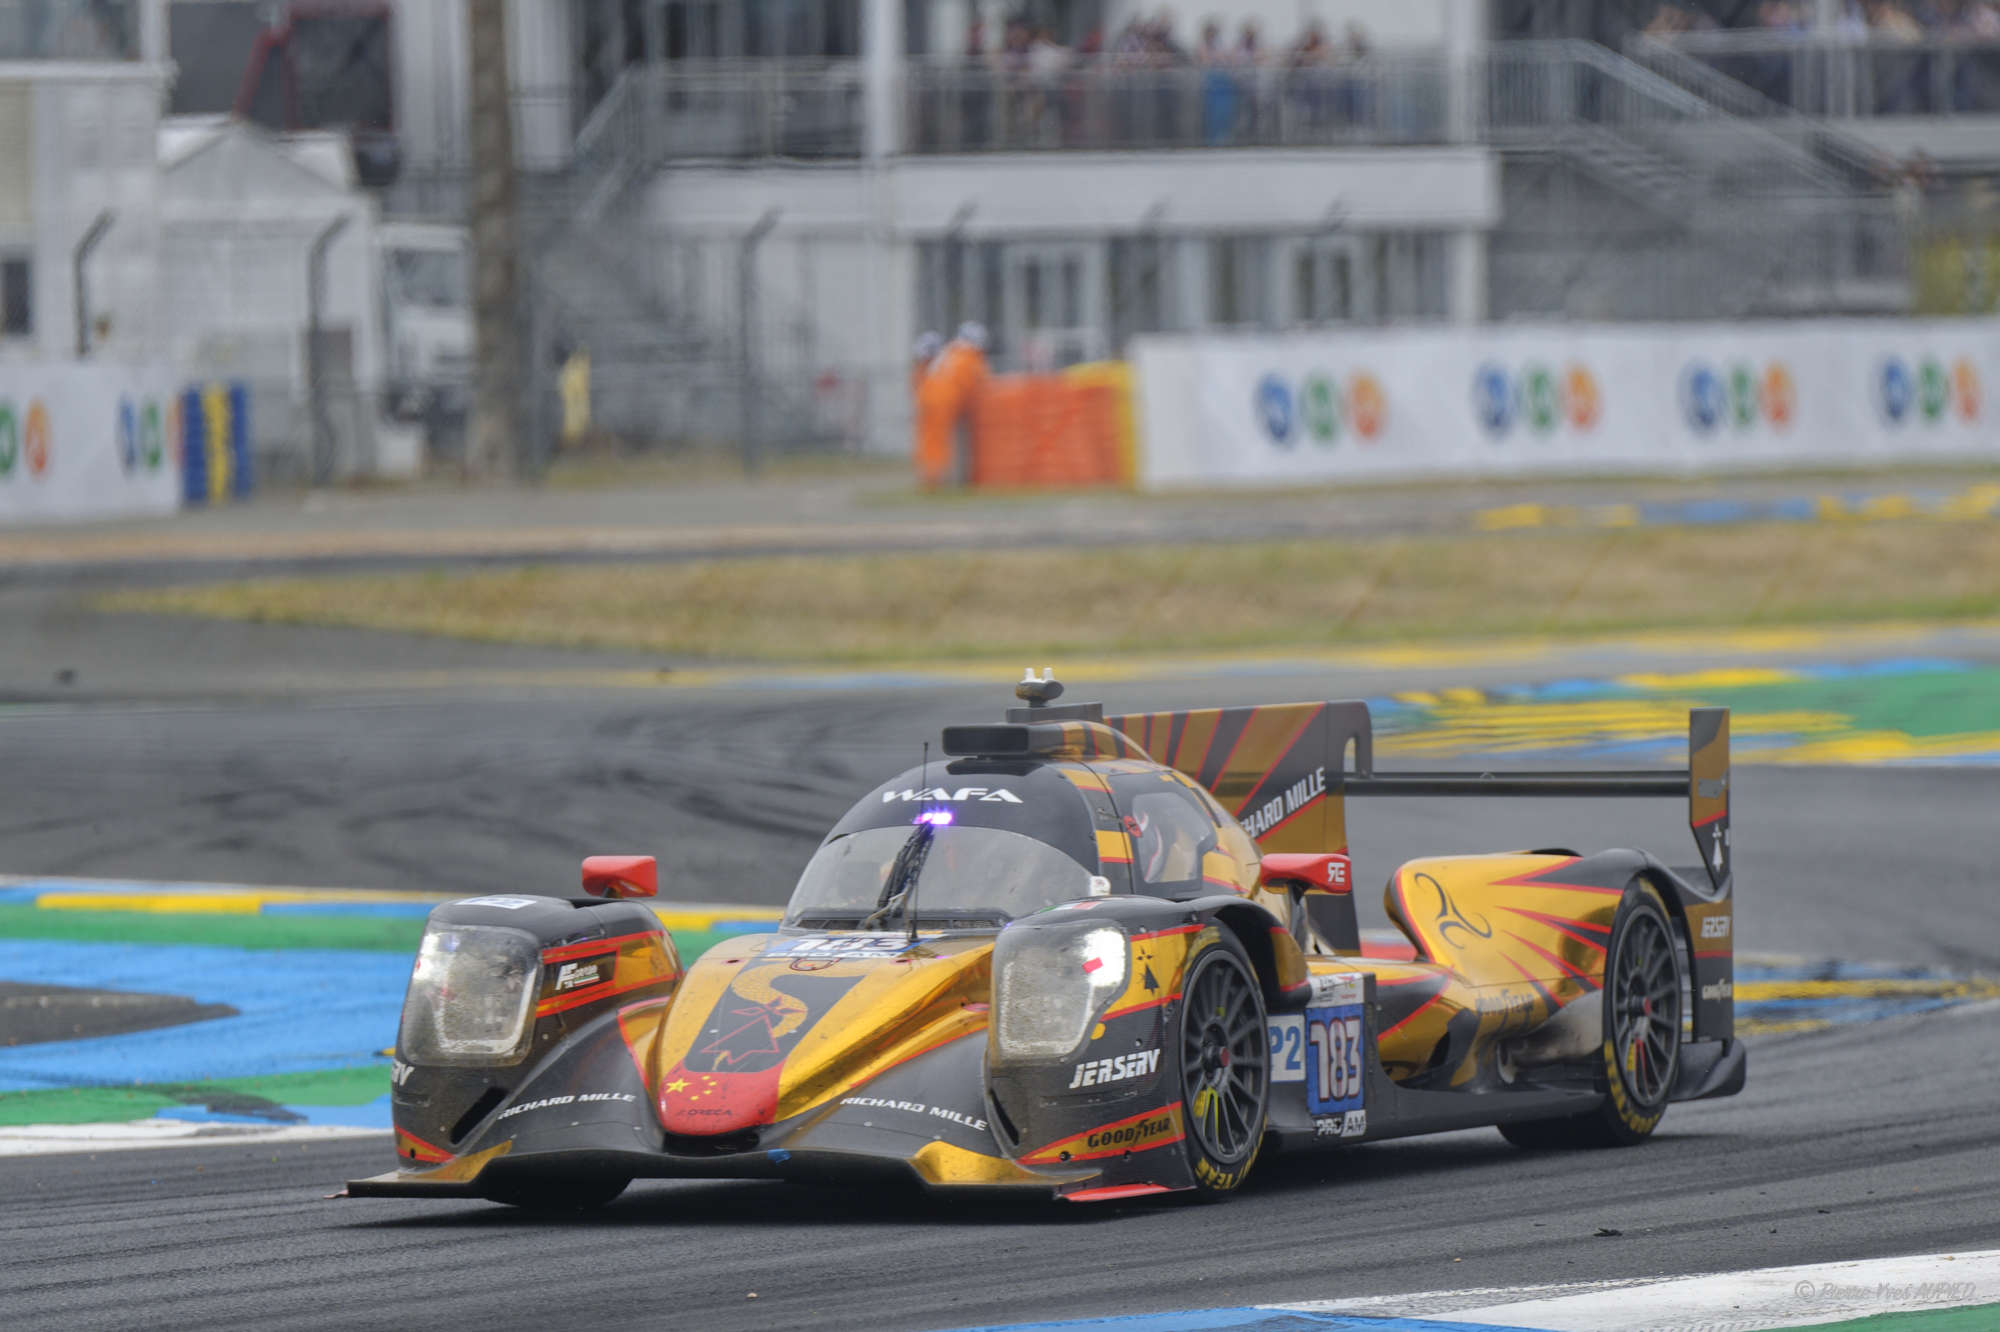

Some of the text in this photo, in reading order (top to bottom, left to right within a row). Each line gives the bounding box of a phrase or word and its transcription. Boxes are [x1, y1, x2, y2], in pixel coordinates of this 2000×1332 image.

[882, 787, 1024, 803] WAFA
[1241, 766, 1326, 838] HARD MILLE
[1269, 1025, 1301, 1071] P2
[1309, 1015, 1361, 1102] 183
[1068, 1048, 1161, 1089] JERSERV
[498, 1092, 636, 1120] RICHARD MILLE
[840, 1097, 988, 1131] RICHARD MILLE
[1087, 1117, 1171, 1148] GOODYEAR
